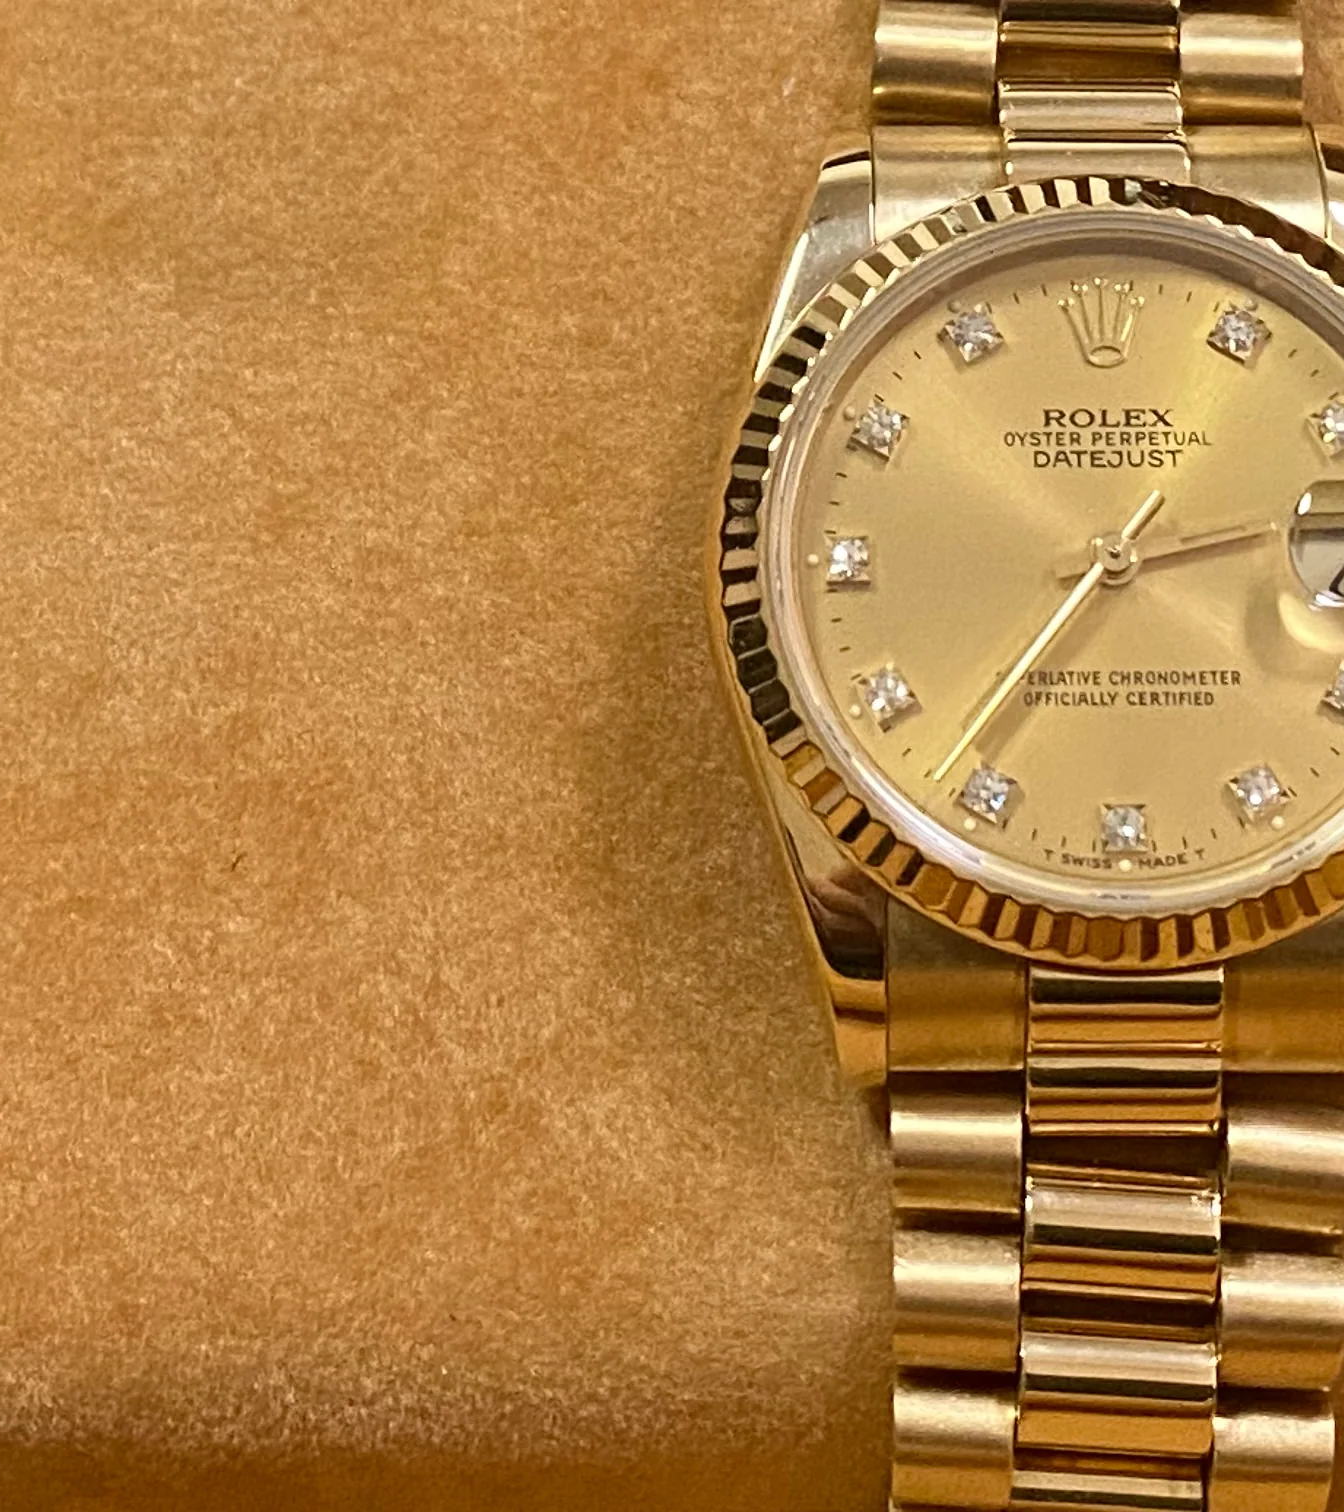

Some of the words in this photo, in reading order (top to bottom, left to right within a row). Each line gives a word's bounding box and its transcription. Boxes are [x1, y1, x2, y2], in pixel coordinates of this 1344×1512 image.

[1043, 408, 1174, 428] ROLEX
[1004, 431, 1082, 448] OYSTER
[1090, 431, 1212, 447] PERPETUAL
[1033, 449, 1184, 469] DATEJUST
[1108, 670, 1241, 687] CHRONOMETER
[1023, 691, 1119, 707] OFFICIALLY
[1126, 691, 1215, 707] CERTIFIED
[1043, 848, 1055, 861] T
[1061, 854, 1112, 870] SWISS
[1139, 851, 1187, 869] MADE
[1194, 848, 1205, 861] T
